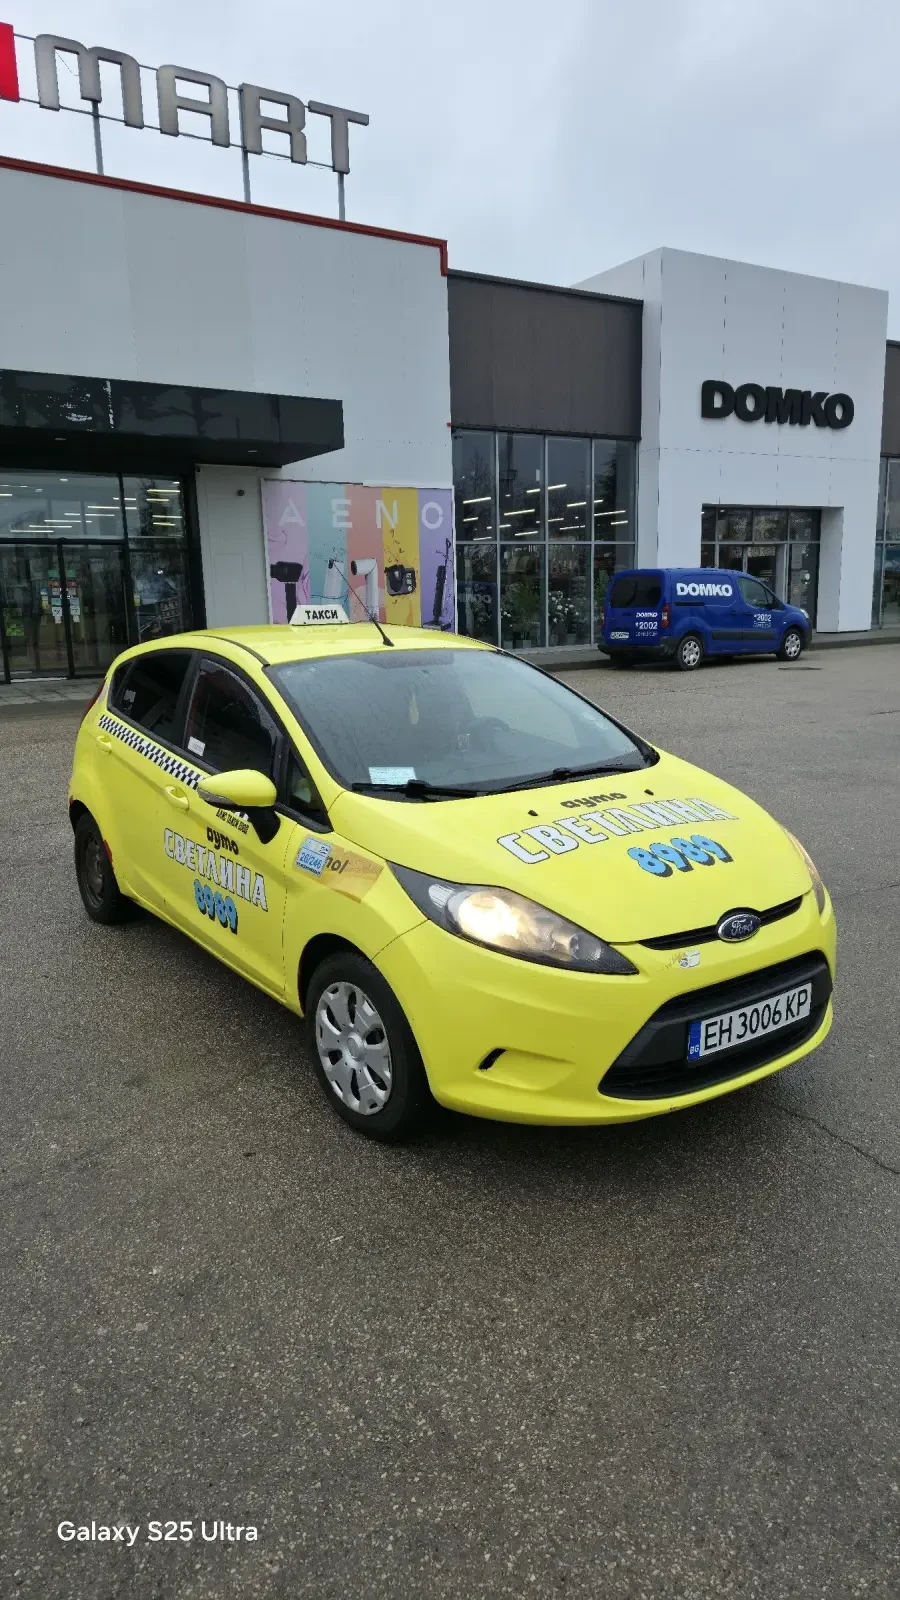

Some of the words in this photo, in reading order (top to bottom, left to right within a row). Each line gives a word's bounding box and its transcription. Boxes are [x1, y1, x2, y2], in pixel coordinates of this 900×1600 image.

[701, 380, 854, 429] DOMKO
[278, 498, 444, 530] AENO
[676, 582, 733, 597] DOMKO
[305, 609, 339, 620] ТАКСИ
[497, 798, 740, 865] СВЕТЛИНА
[163, 827, 269, 912] СВЕТЛИНА
[627, 834, 734, 877] 8989
[193, 878, 238, 935] 8989
[730, 917, 754, 936] Ford
[736, 998, 783, 1040] 3006
[689, 1044, 700, 1054] BG
